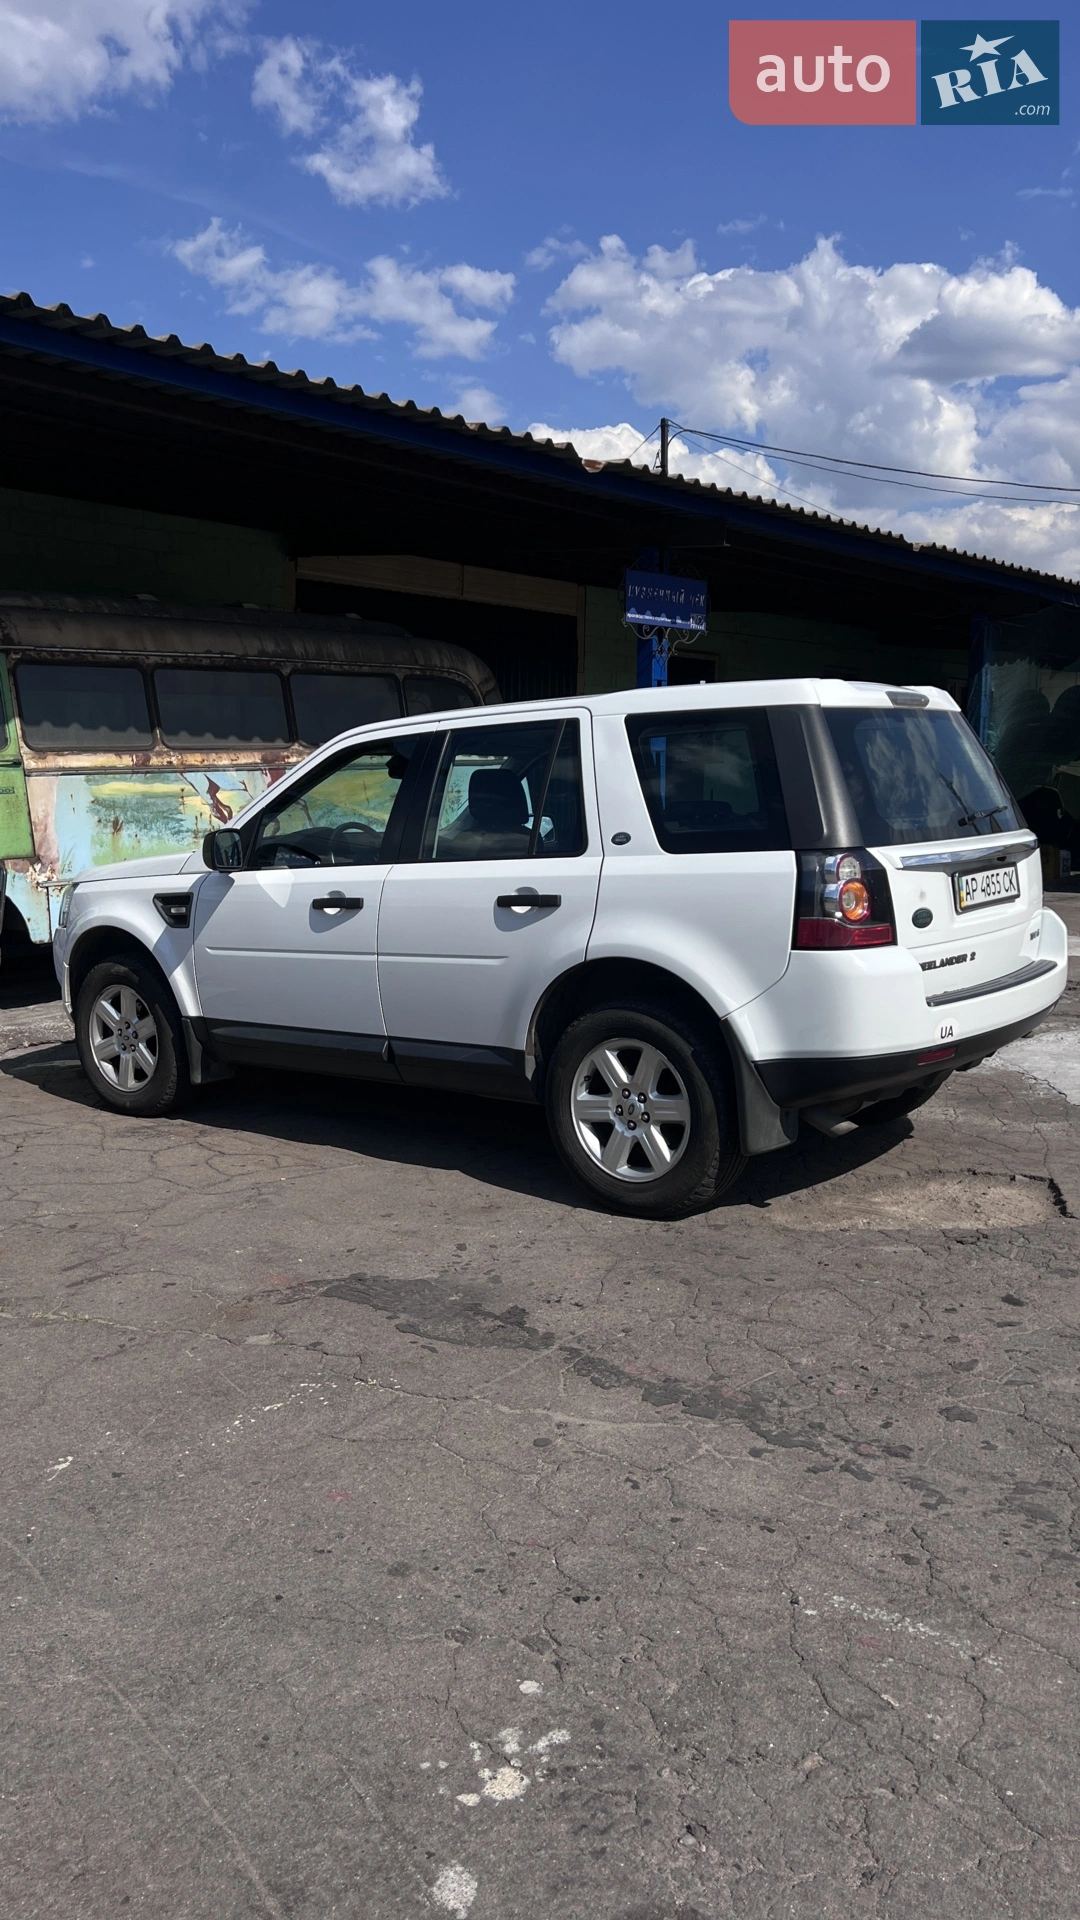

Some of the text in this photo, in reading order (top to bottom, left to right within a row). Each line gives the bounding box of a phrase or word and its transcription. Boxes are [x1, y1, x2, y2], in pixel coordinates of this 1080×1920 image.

[965, 869, 1017, 902] AP 4855 CK
[969, 951, 977, 962] 2
[940, 1025, 954, 1040] UA
